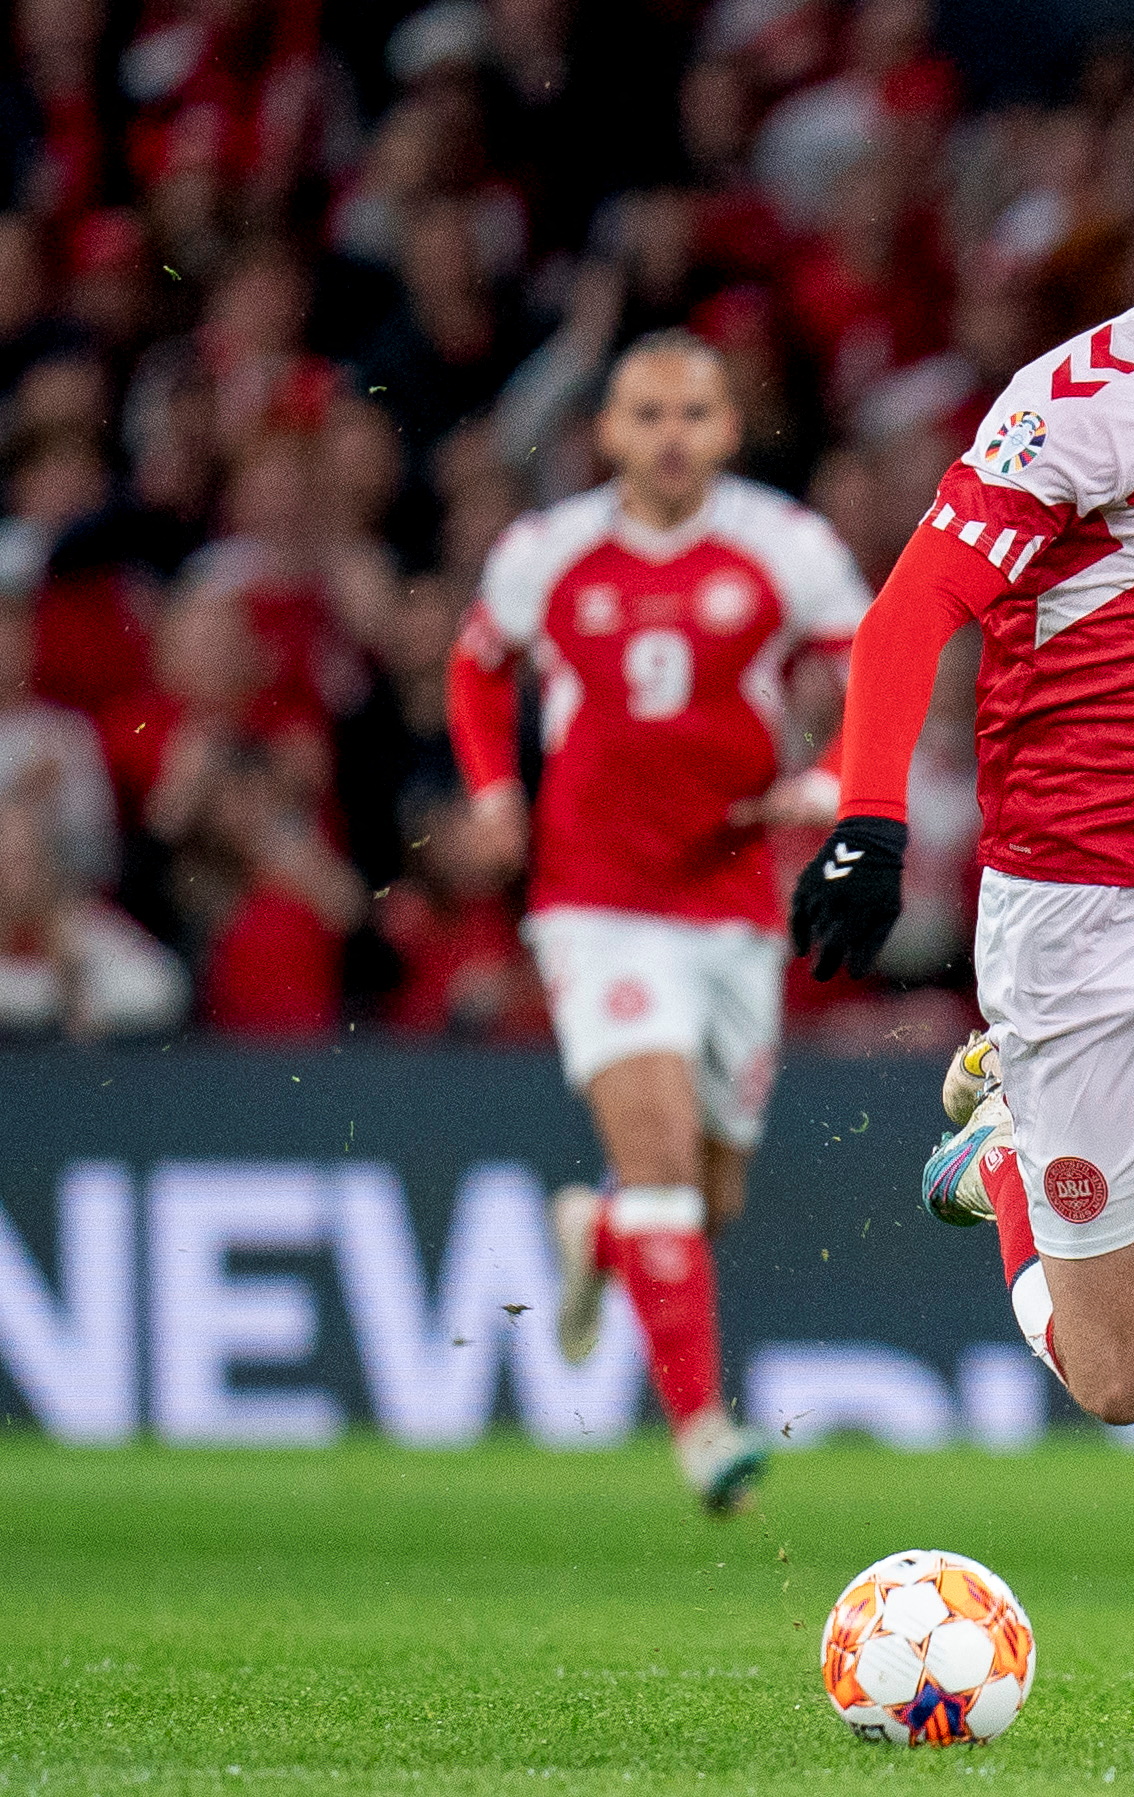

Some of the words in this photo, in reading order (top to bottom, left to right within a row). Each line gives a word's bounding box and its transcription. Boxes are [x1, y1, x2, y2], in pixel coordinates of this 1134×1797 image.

[623, 631, 695, 721] 9
[1057, 1180, 1091, 1197] DBU
[0, 1157, 652, 1450] NEW
